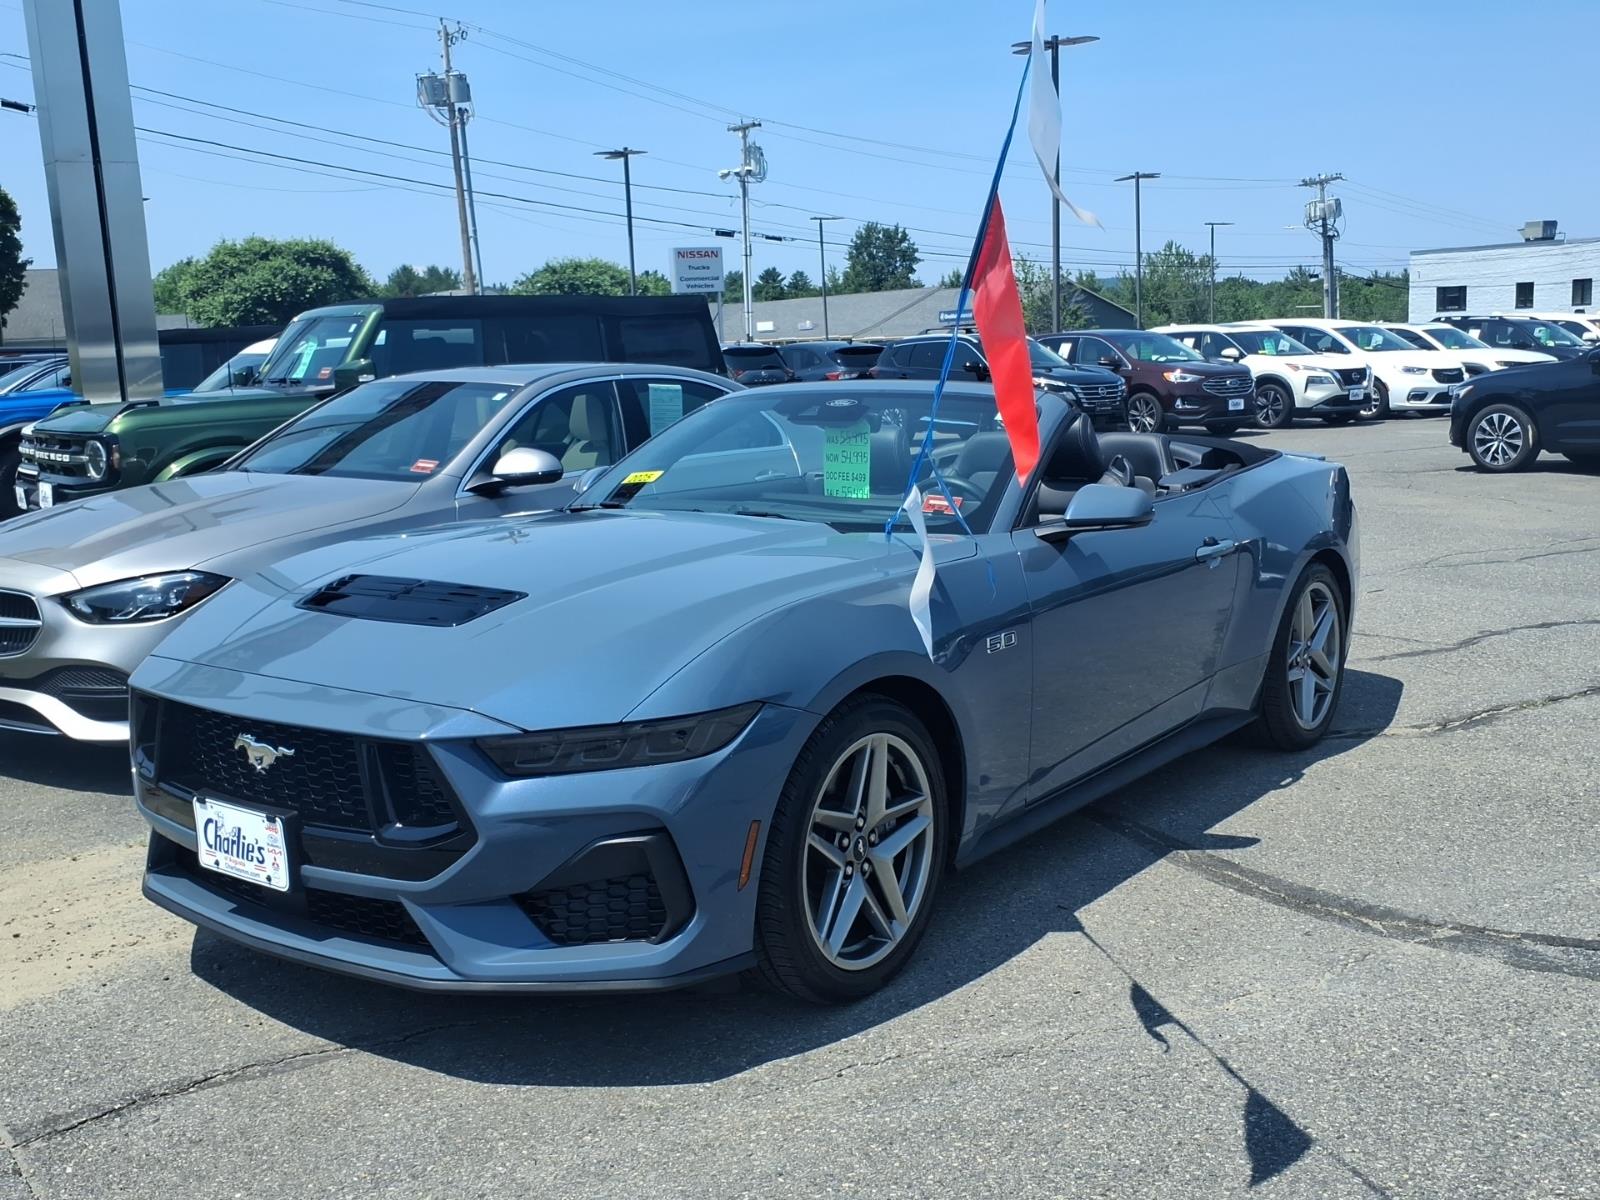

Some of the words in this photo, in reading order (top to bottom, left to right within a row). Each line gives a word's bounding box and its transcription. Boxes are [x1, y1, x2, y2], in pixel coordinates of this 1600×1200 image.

[677, 250, 719, 259] NISSAN
[825, 453, 839, 463] NOW
[841, 449, 868, 464] 54,995
[825, 471, 838, 480] DOC
[838, 472, 850, 481] FEE
[203, 817, 265, 865] Charlie's
